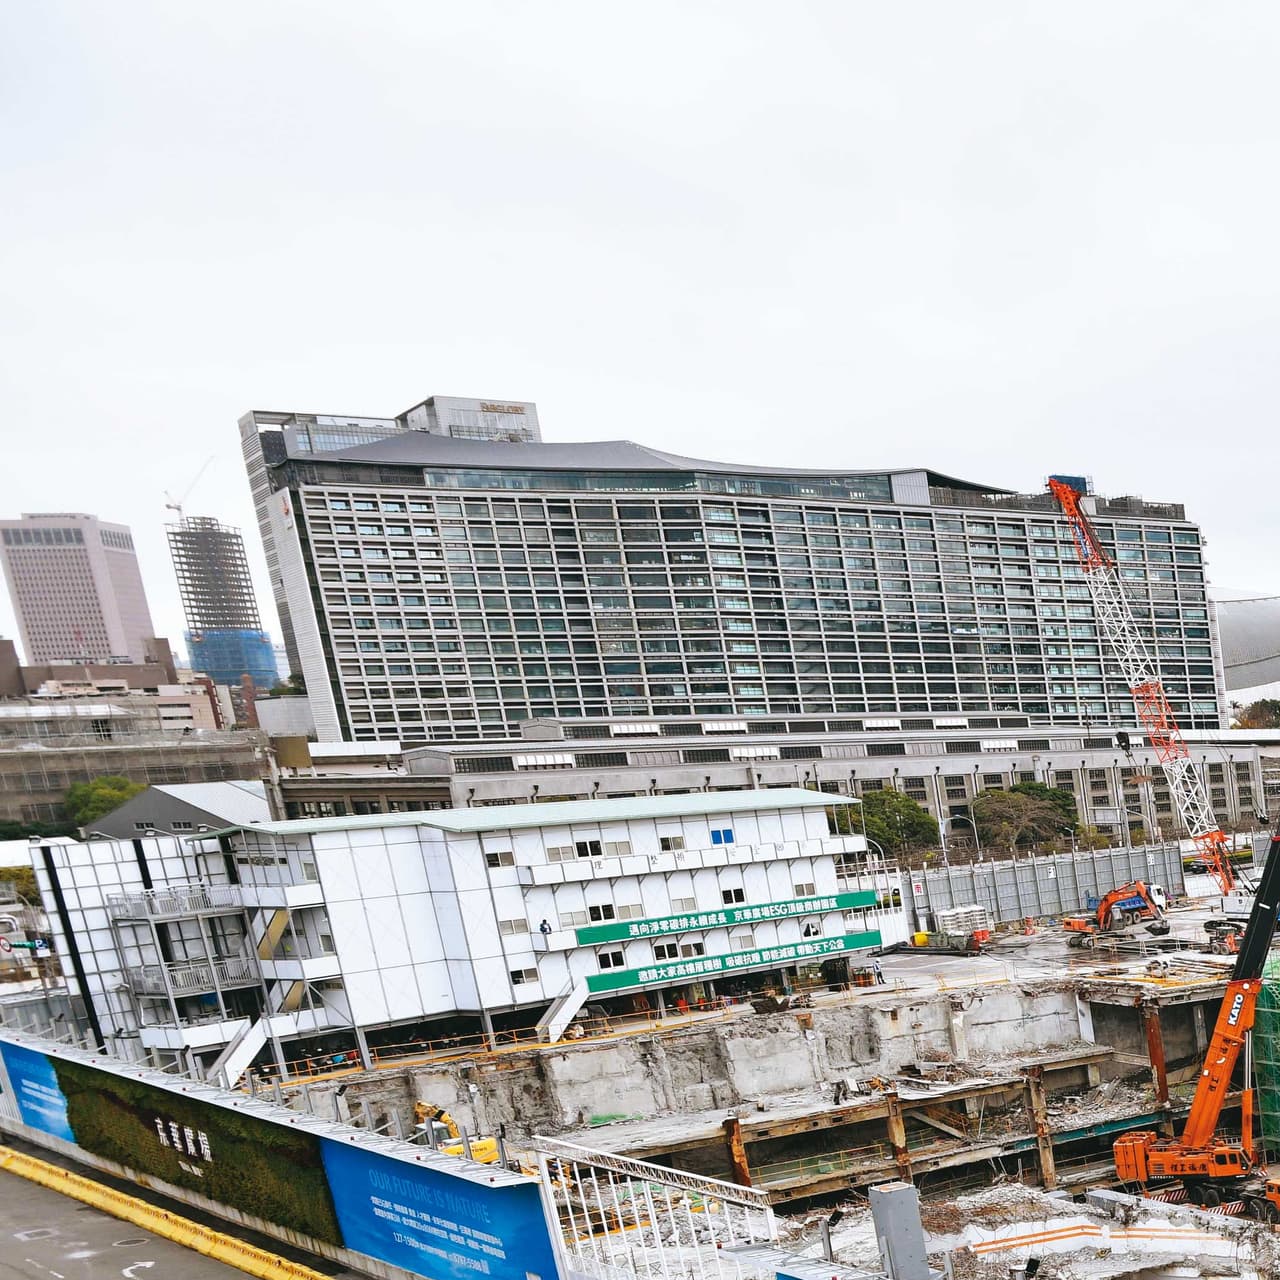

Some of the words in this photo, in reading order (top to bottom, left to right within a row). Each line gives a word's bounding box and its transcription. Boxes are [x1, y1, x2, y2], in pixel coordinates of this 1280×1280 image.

[1227, 994, 1244, 1026] KATO
[368, 1168, 393, 1194] OUR
[393, 1175, 433, 1205] FUTURE
